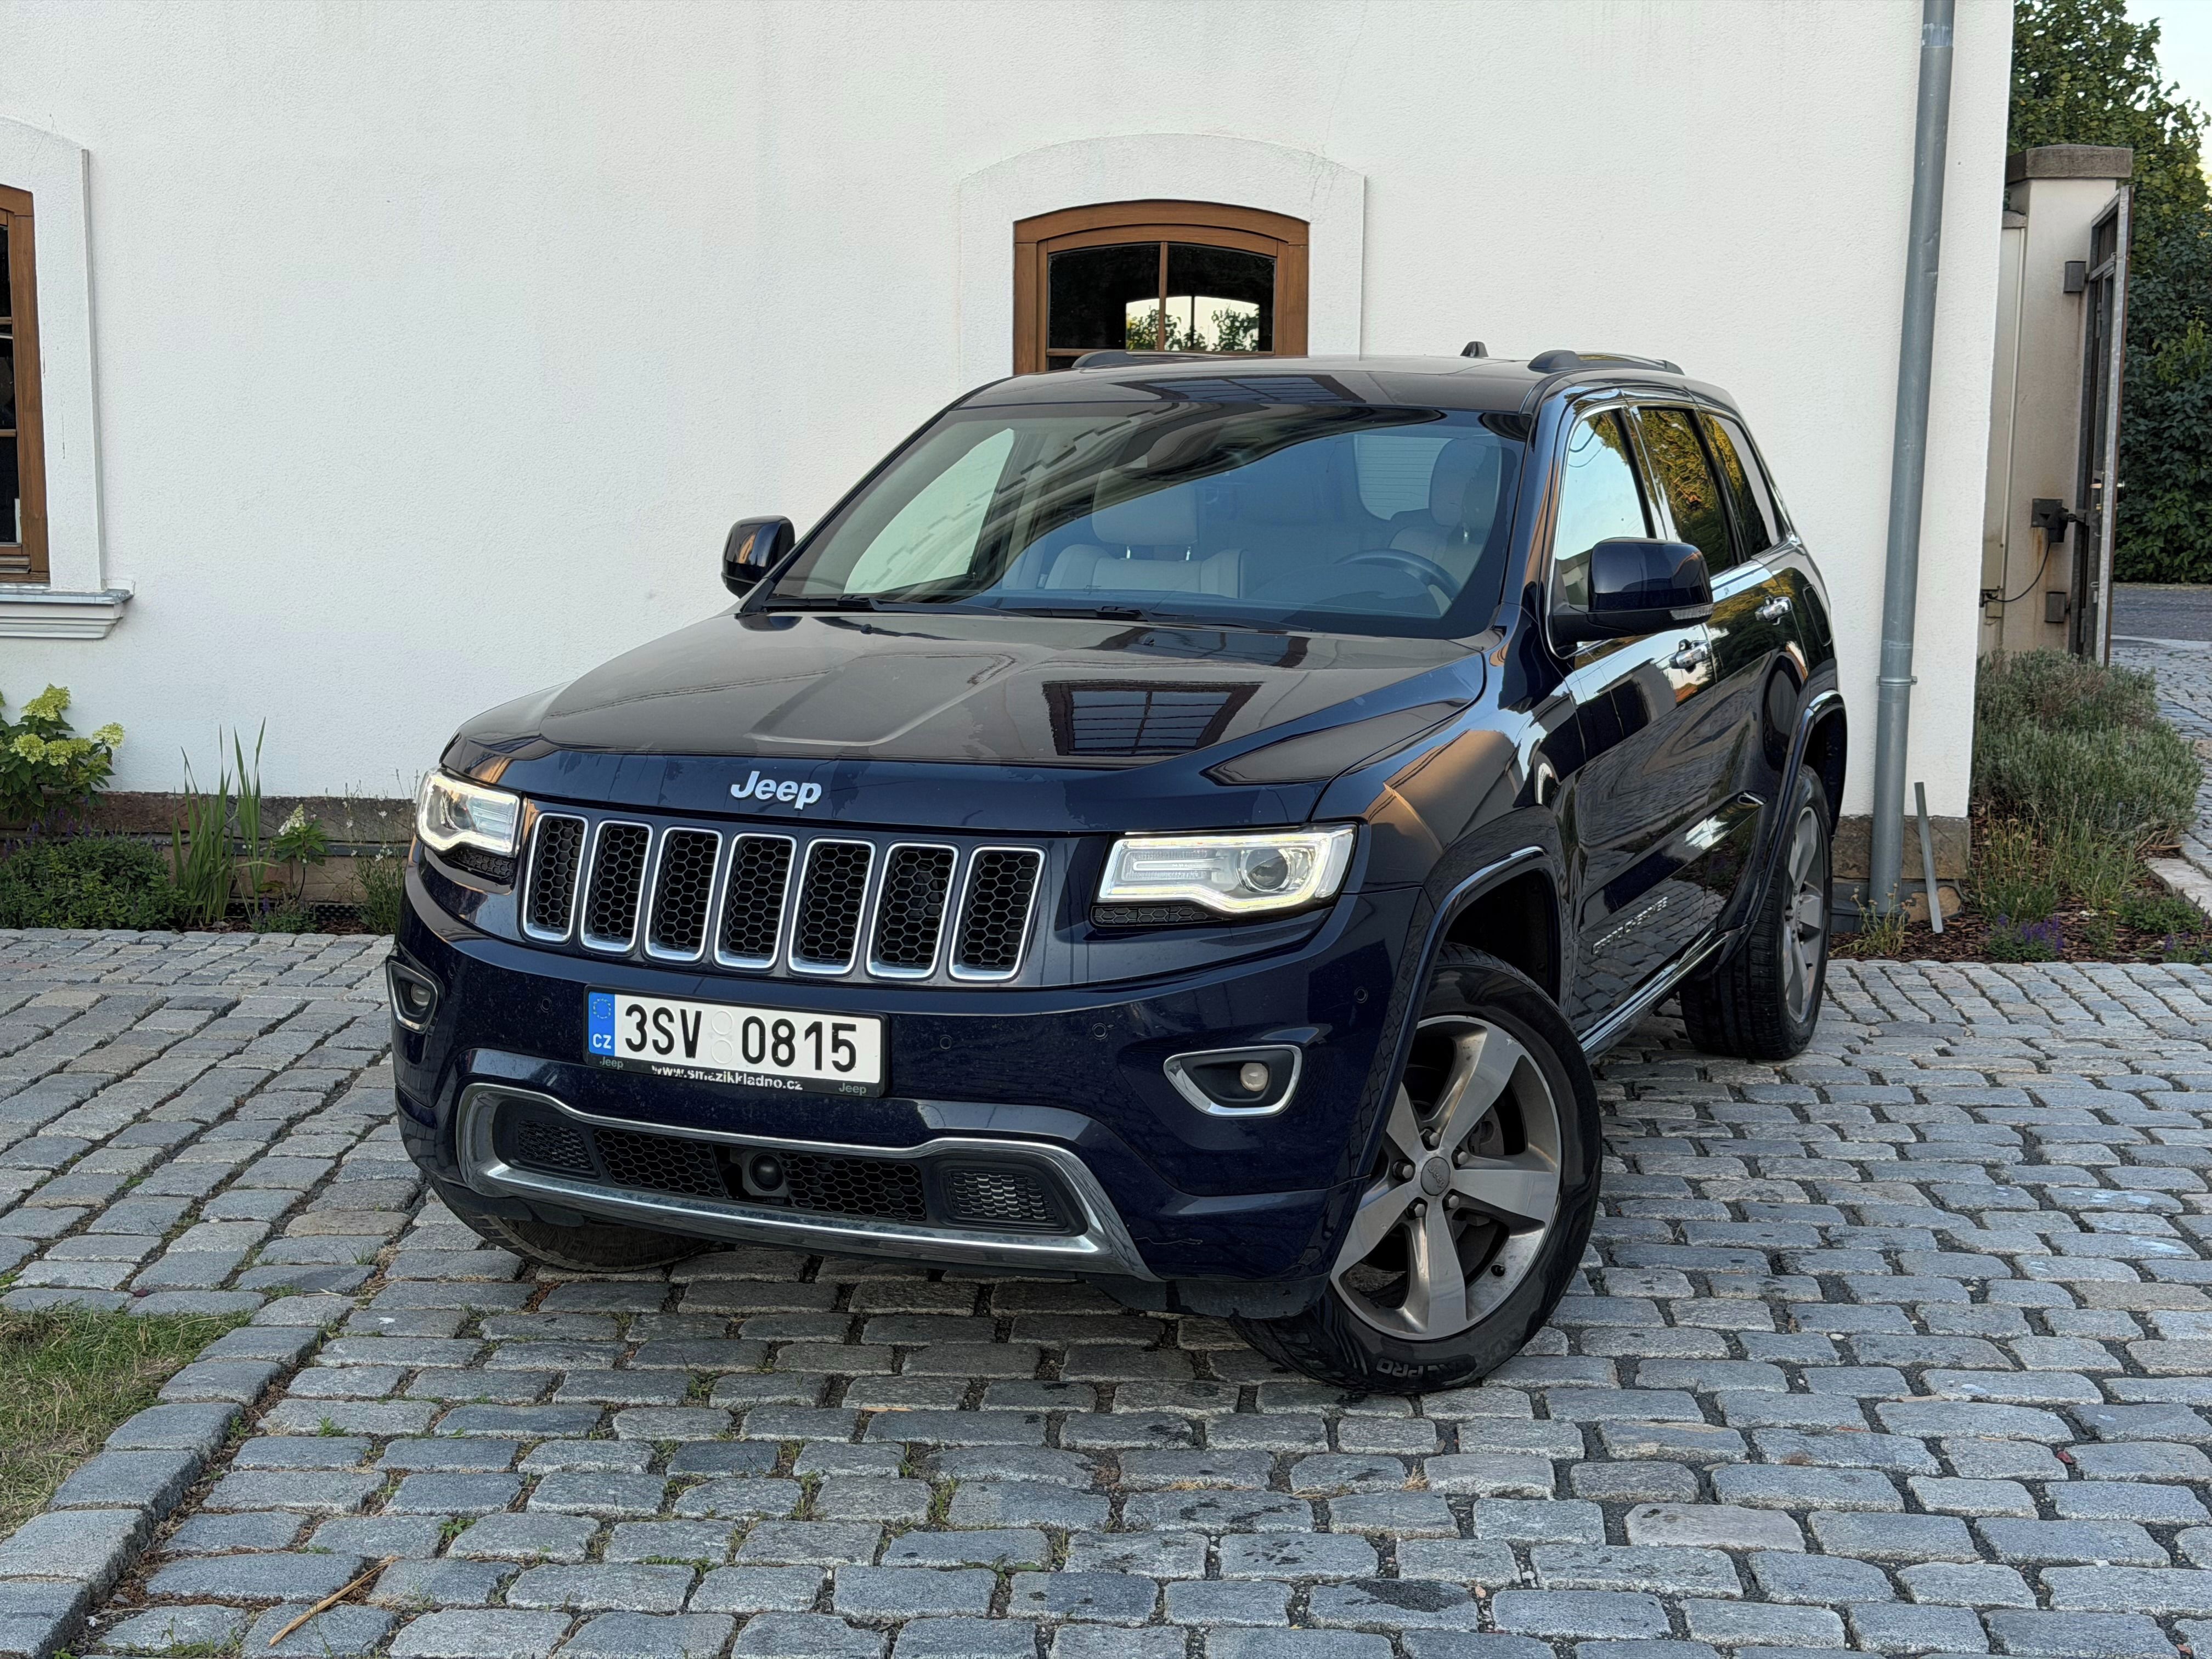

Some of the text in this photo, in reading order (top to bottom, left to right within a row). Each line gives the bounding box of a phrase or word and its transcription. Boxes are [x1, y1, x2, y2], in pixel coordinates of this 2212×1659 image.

[731, 771, 821, 810] Jeep
[592, 1034, 612, 1049] CZ
[624, 1004, 857, 1073] 3SV 0815
[599, 1058, 624, 1069] Jeep
[839, 1083, 867, 1095] Jeep
[1428, 1166, 1446, 1189] Jeep
